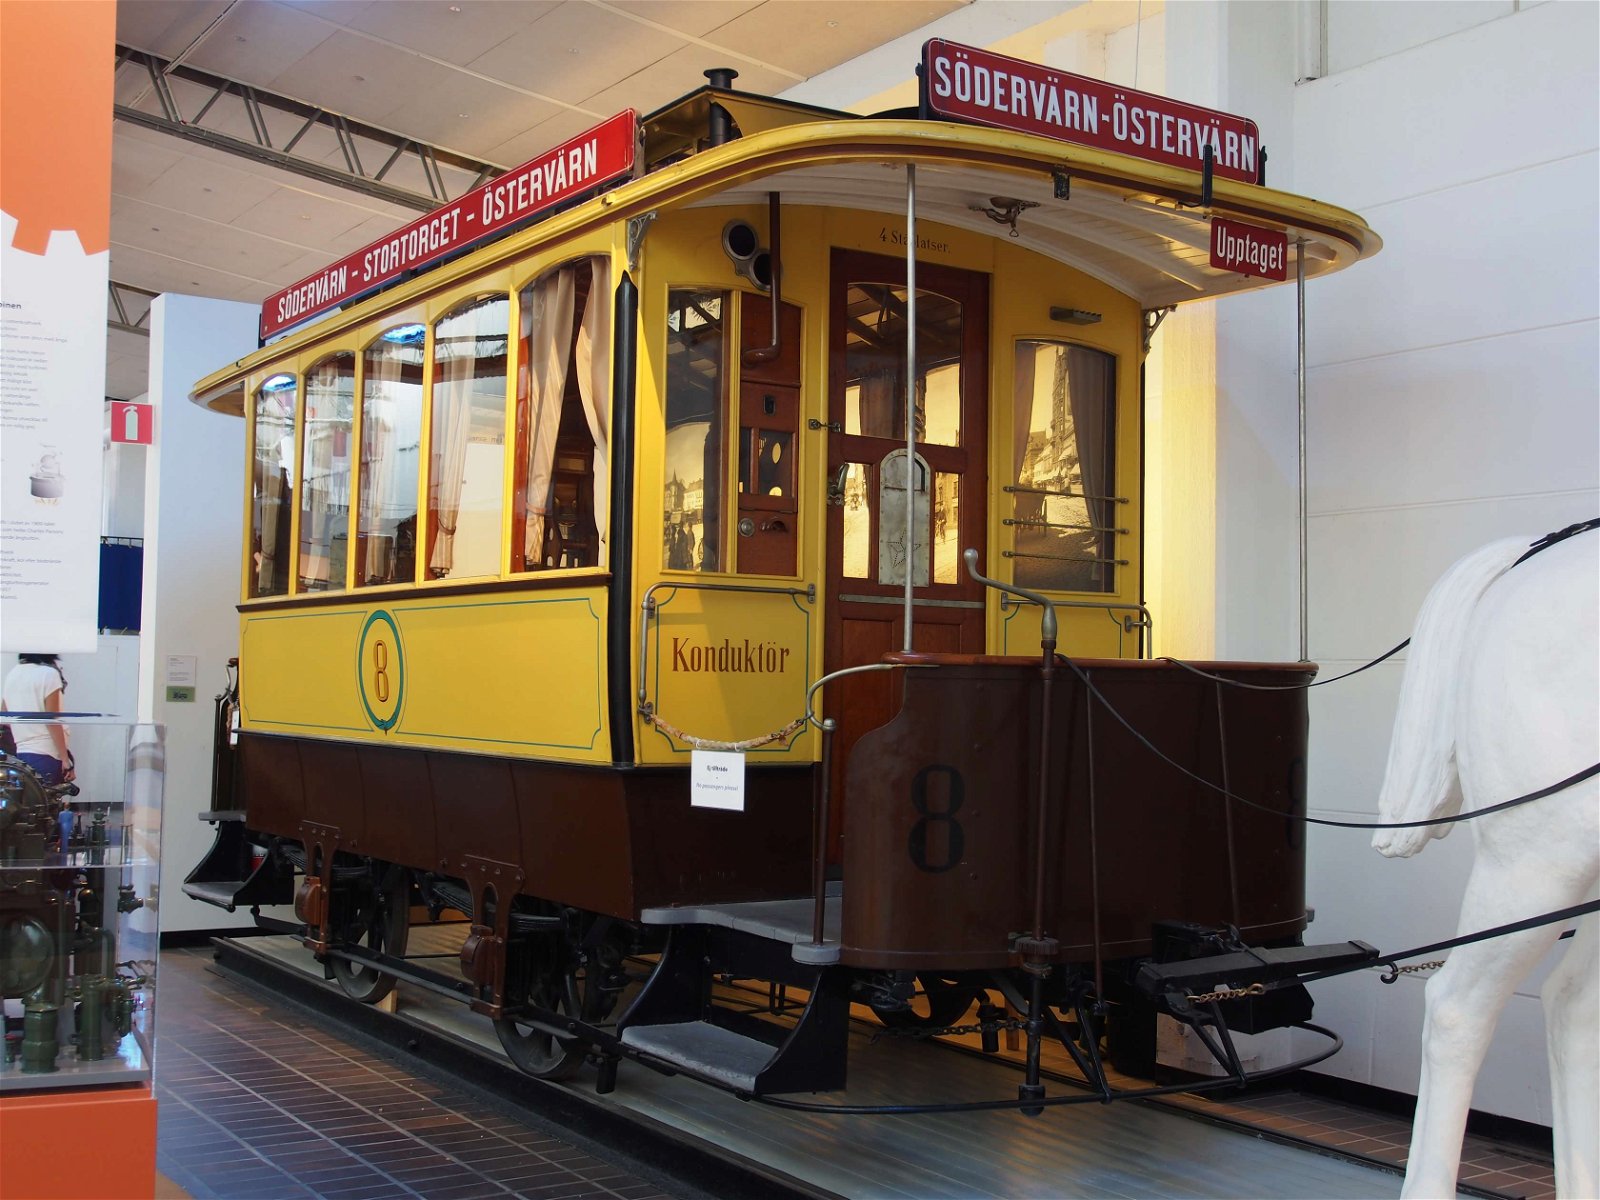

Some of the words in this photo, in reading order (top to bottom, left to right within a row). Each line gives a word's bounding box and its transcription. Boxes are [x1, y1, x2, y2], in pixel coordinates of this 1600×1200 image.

[277, 264, 348, 324] SÖDERVÄRN
[363, 207, 461, 282] STORTORGET
[482, 138, 598, 226] ÖSTERVÄRN
[879, 227, 887, 242] 4
[891, 230, 951, 254] Stålatser.
[1216, 225, 1284, 274] Upptaget
[373, 639, 390, 702] 8
[672, 637, 790, 673] Konduktör
[908, 764, 966, 873] 8
